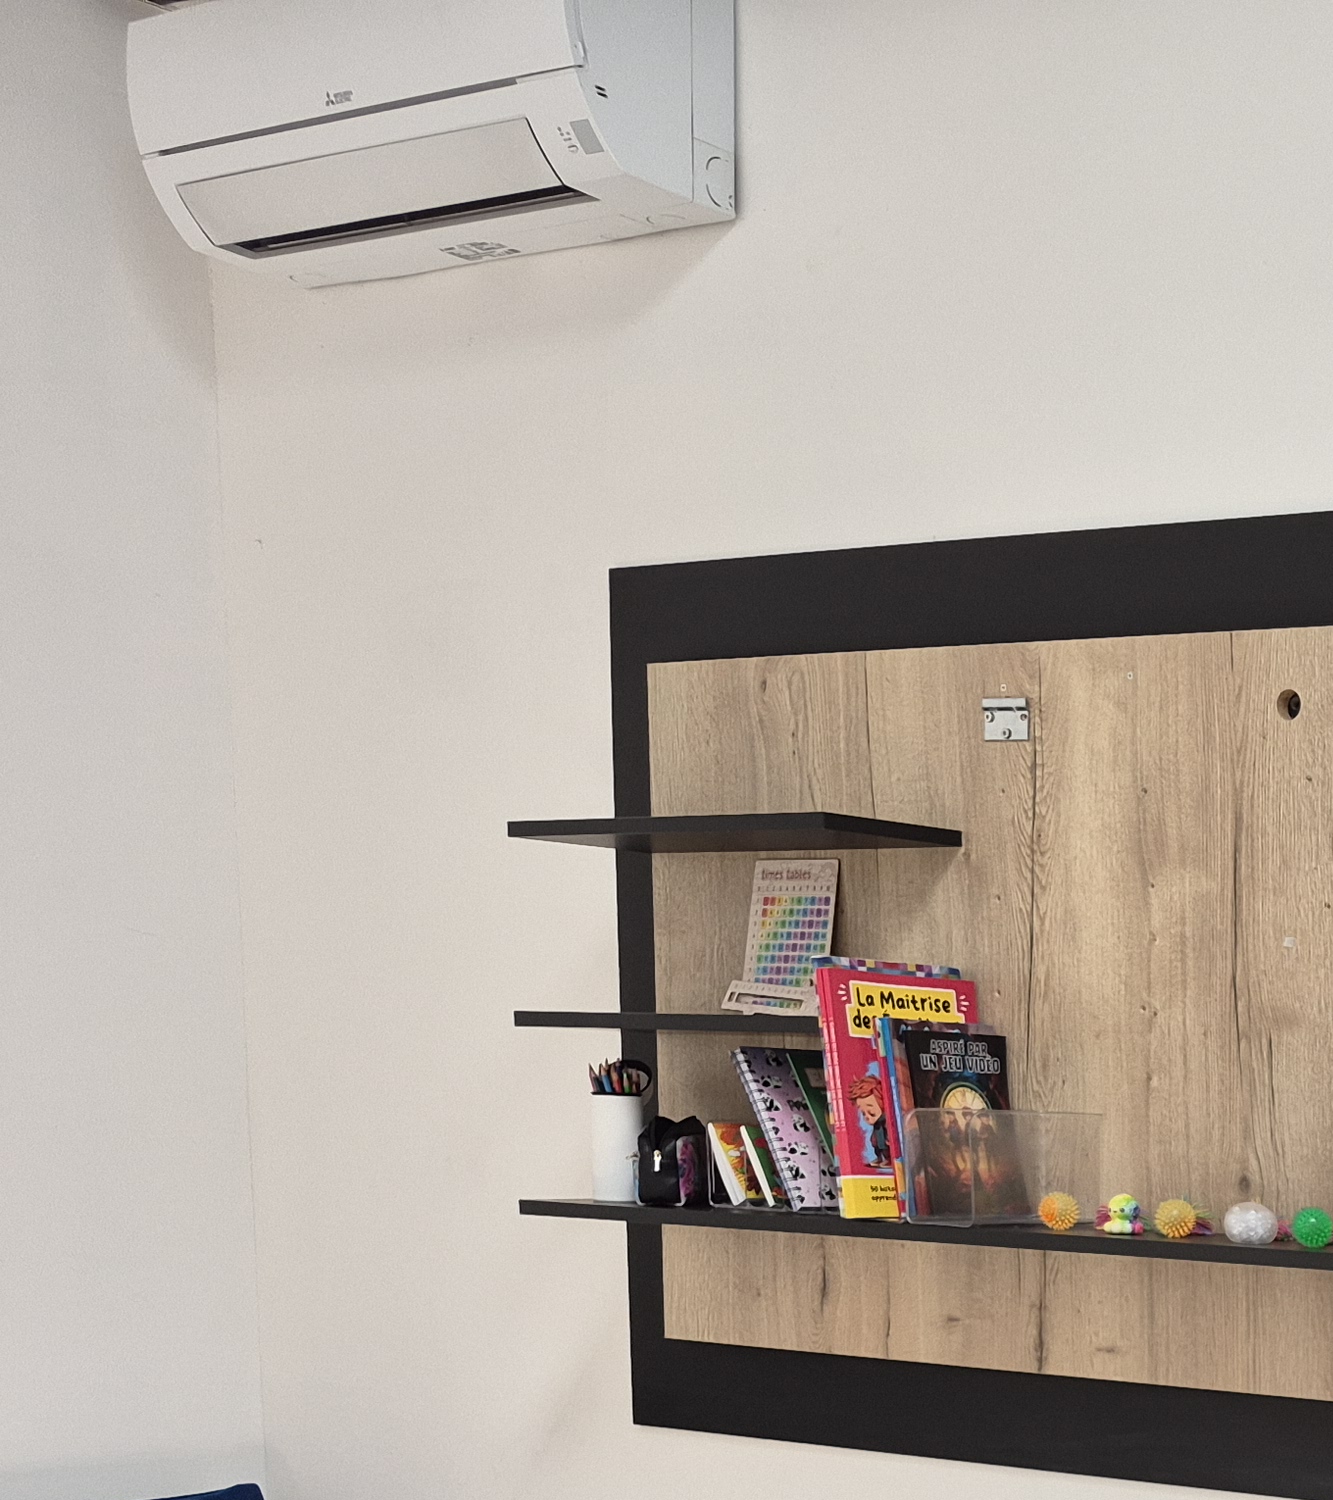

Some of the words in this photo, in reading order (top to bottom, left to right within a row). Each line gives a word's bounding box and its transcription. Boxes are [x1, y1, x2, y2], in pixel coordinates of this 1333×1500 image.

[761, 870, 783, 881] times
[786, 869, 811, 881] tables
[856, 987, 875, 1008] La
[853, 1009, 876, 1029] de
[930, 1037, 965, 1056] ASPIRÉ
[967, 1042, 989, 1057] PAR
[919, 1053, 938, 1071] UN
[941, 1056, 963, 1072] JEU
[964, 1054, 1001, 1074] VIDÉO
